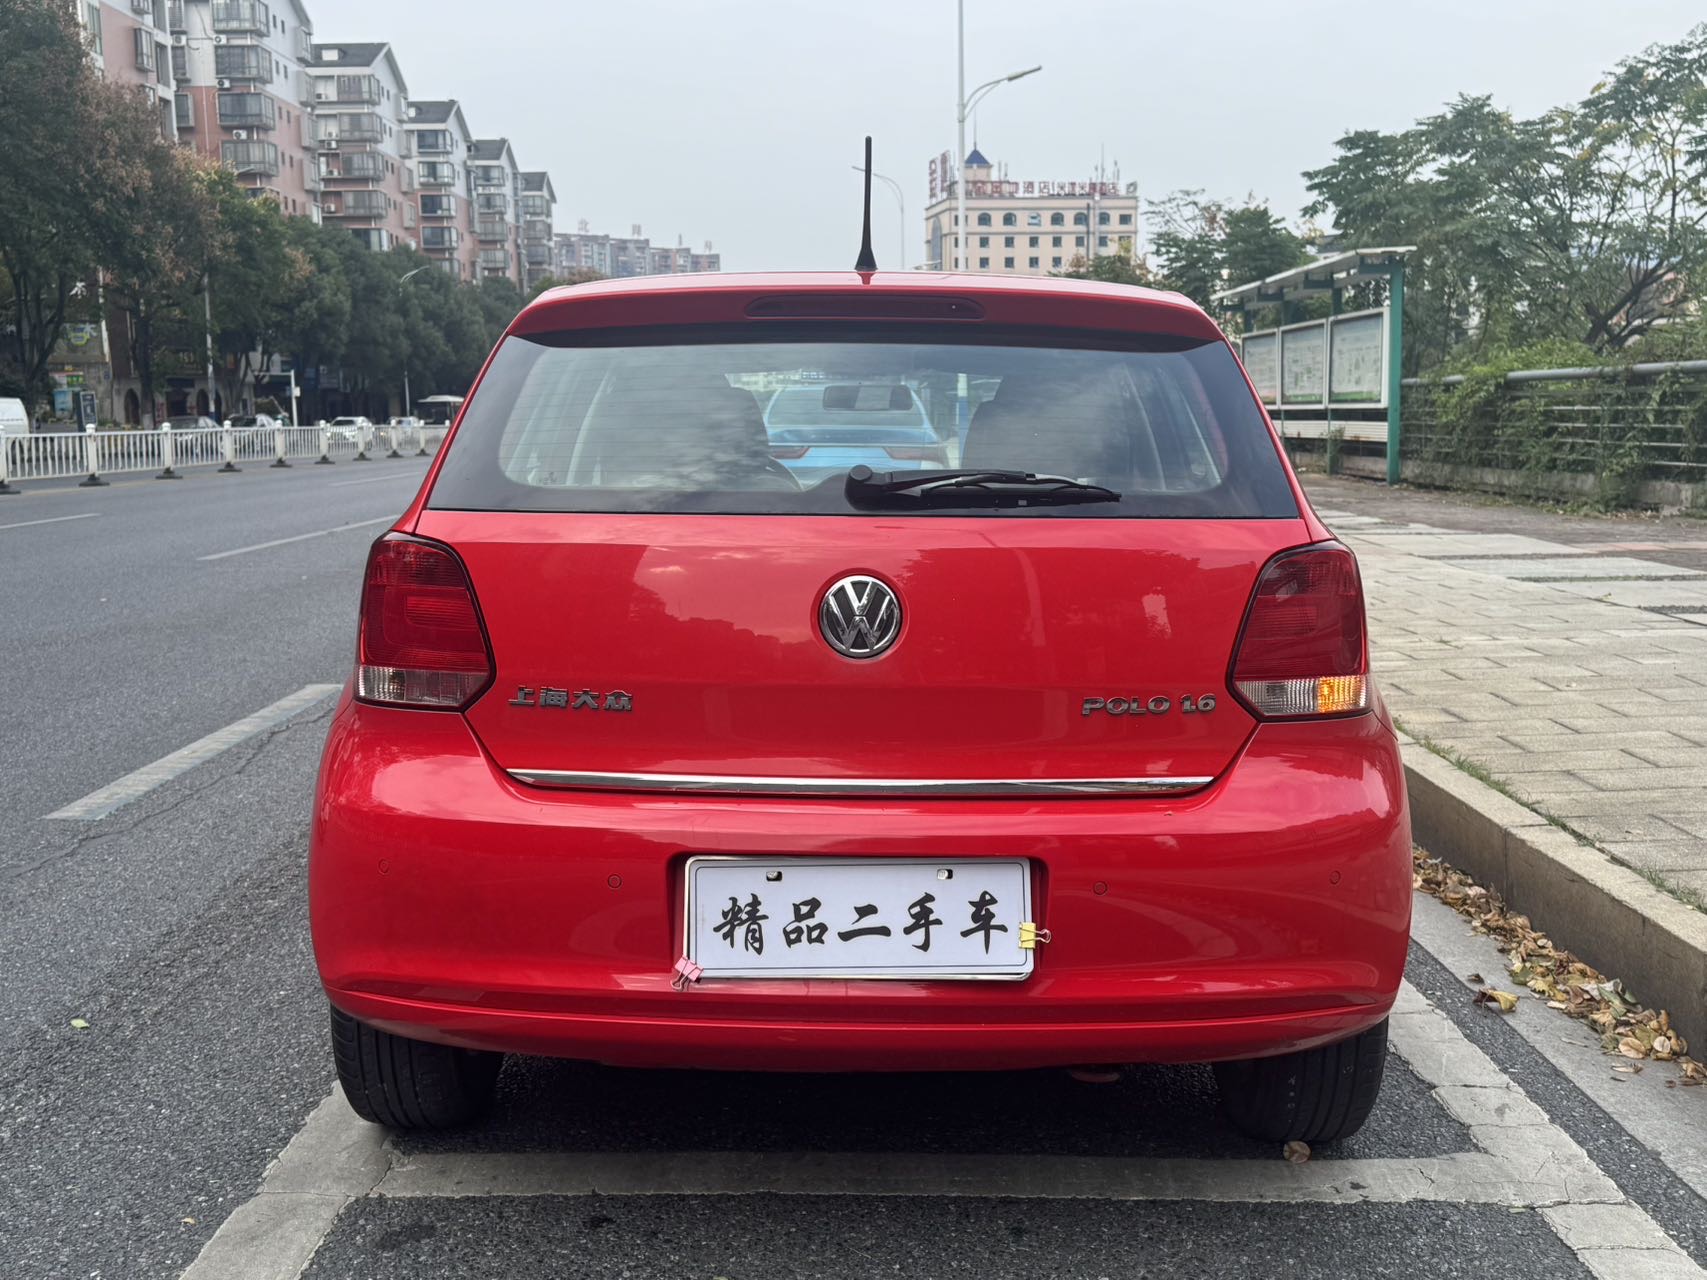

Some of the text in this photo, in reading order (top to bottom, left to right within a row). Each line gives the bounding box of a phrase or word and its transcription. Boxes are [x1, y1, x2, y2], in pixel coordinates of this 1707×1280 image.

[508, 685, 632, 711] 上海大众
[1082, 693, 1216, 715] POLO 1.6
[713, 890, 1008, 956] 精品二手车
